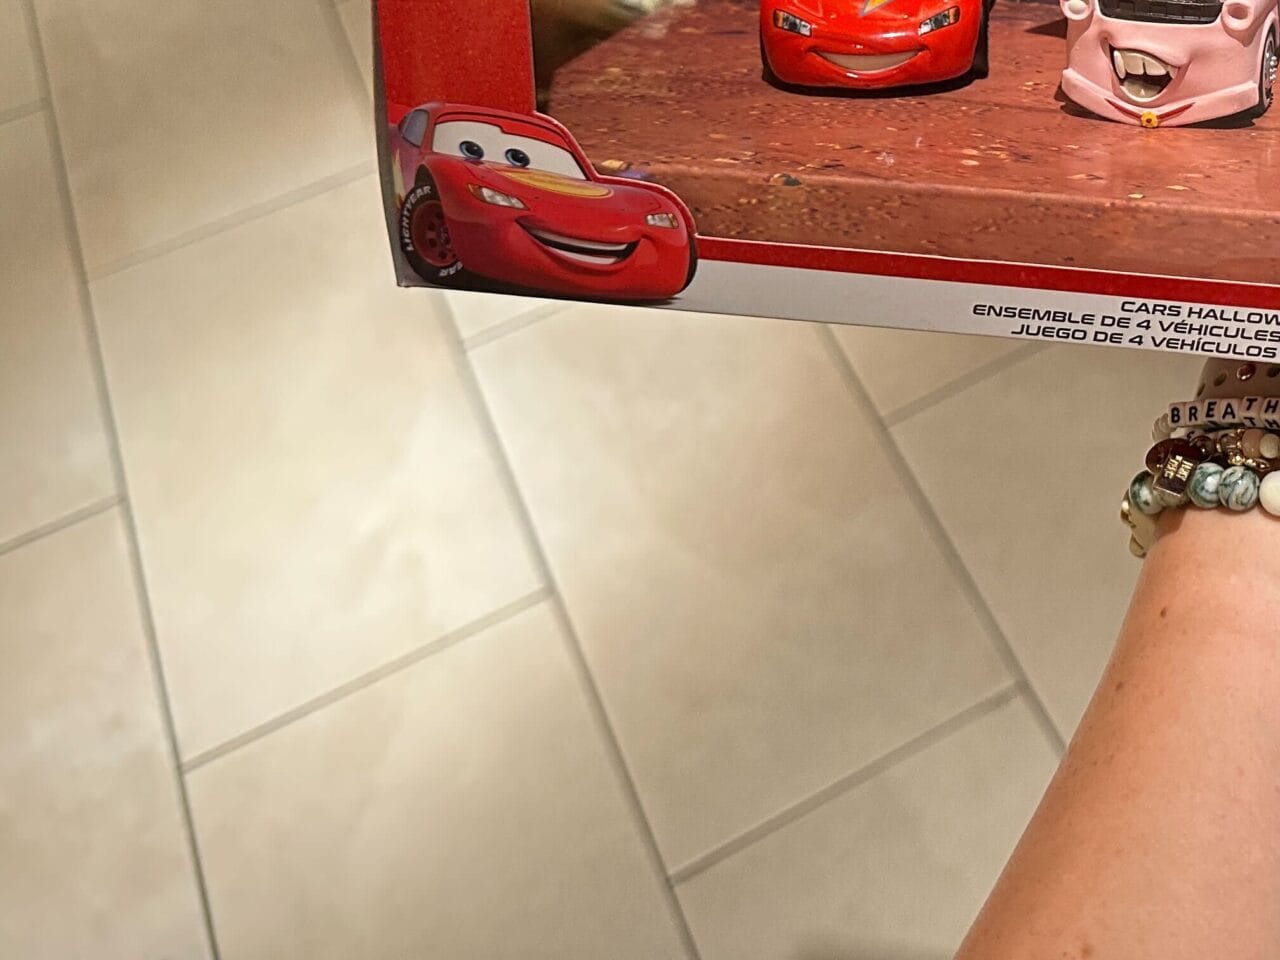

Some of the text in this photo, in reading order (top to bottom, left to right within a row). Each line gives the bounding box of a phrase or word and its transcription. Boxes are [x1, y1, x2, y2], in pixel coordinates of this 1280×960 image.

[972, 303, 1096, 325] ENSEMBLE
[1100, 315, 1131, 329] DE
[1136, 319, 1152, 331] 4
[1120, 300, 1182, 317] CARS
[1011, 323, 1087, 340] JUEGO
[1092, 330, 1124, 344] DE
[1128, 334, 1144, 347] 4
[1150, 336, 1277, 359] VEHÍCULOS
